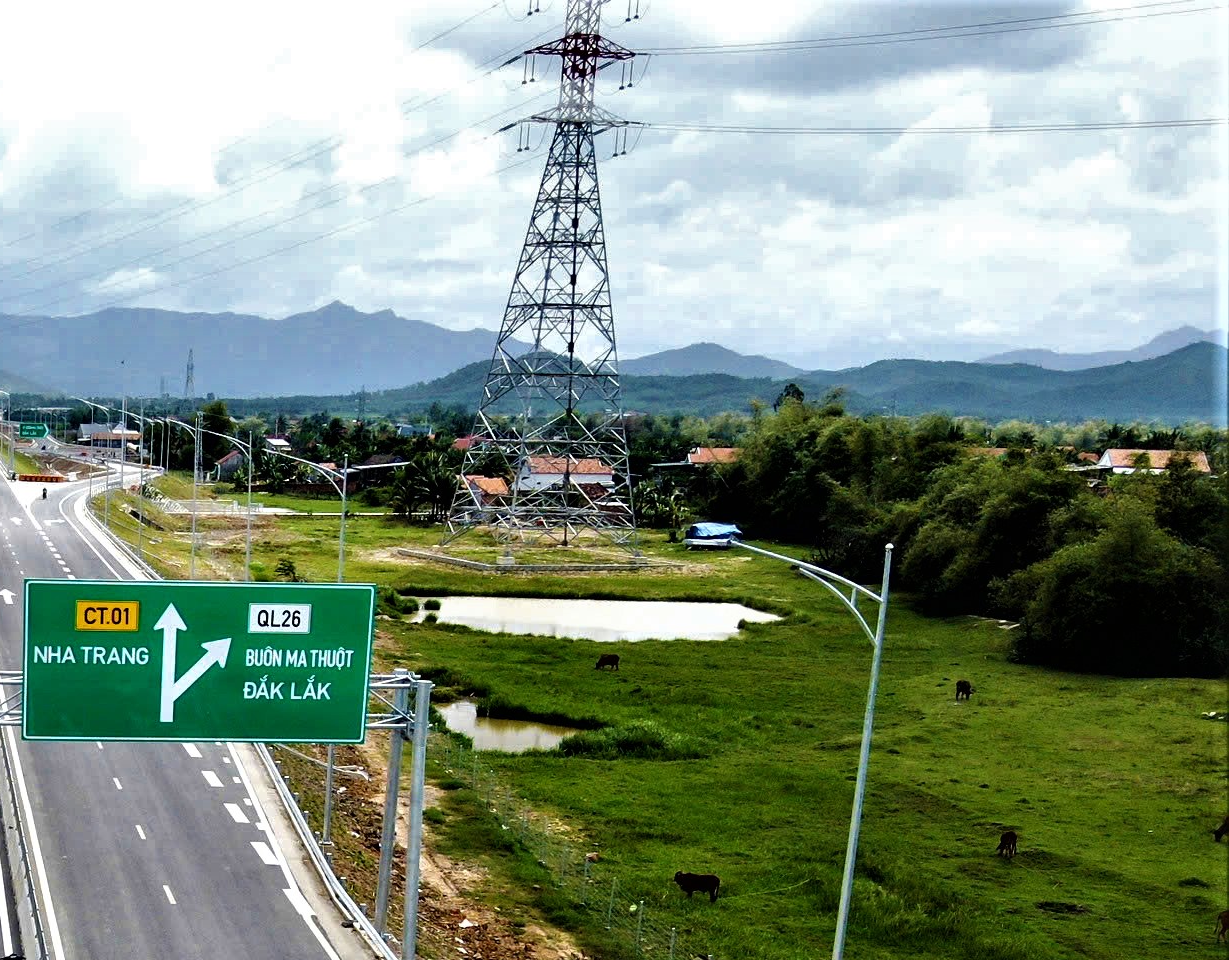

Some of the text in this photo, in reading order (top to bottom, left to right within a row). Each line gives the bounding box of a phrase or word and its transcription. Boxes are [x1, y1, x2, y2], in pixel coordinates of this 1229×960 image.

[84, 607, 130, 625] CT.01
[257, 609, 301, 628] QL26
[34, 646, 149, 665] NHA TRANG
[246, 646, 354, 670] BUÔN MA THUỘT
[243, 675, 331, 700] ĐẮK LẮK
